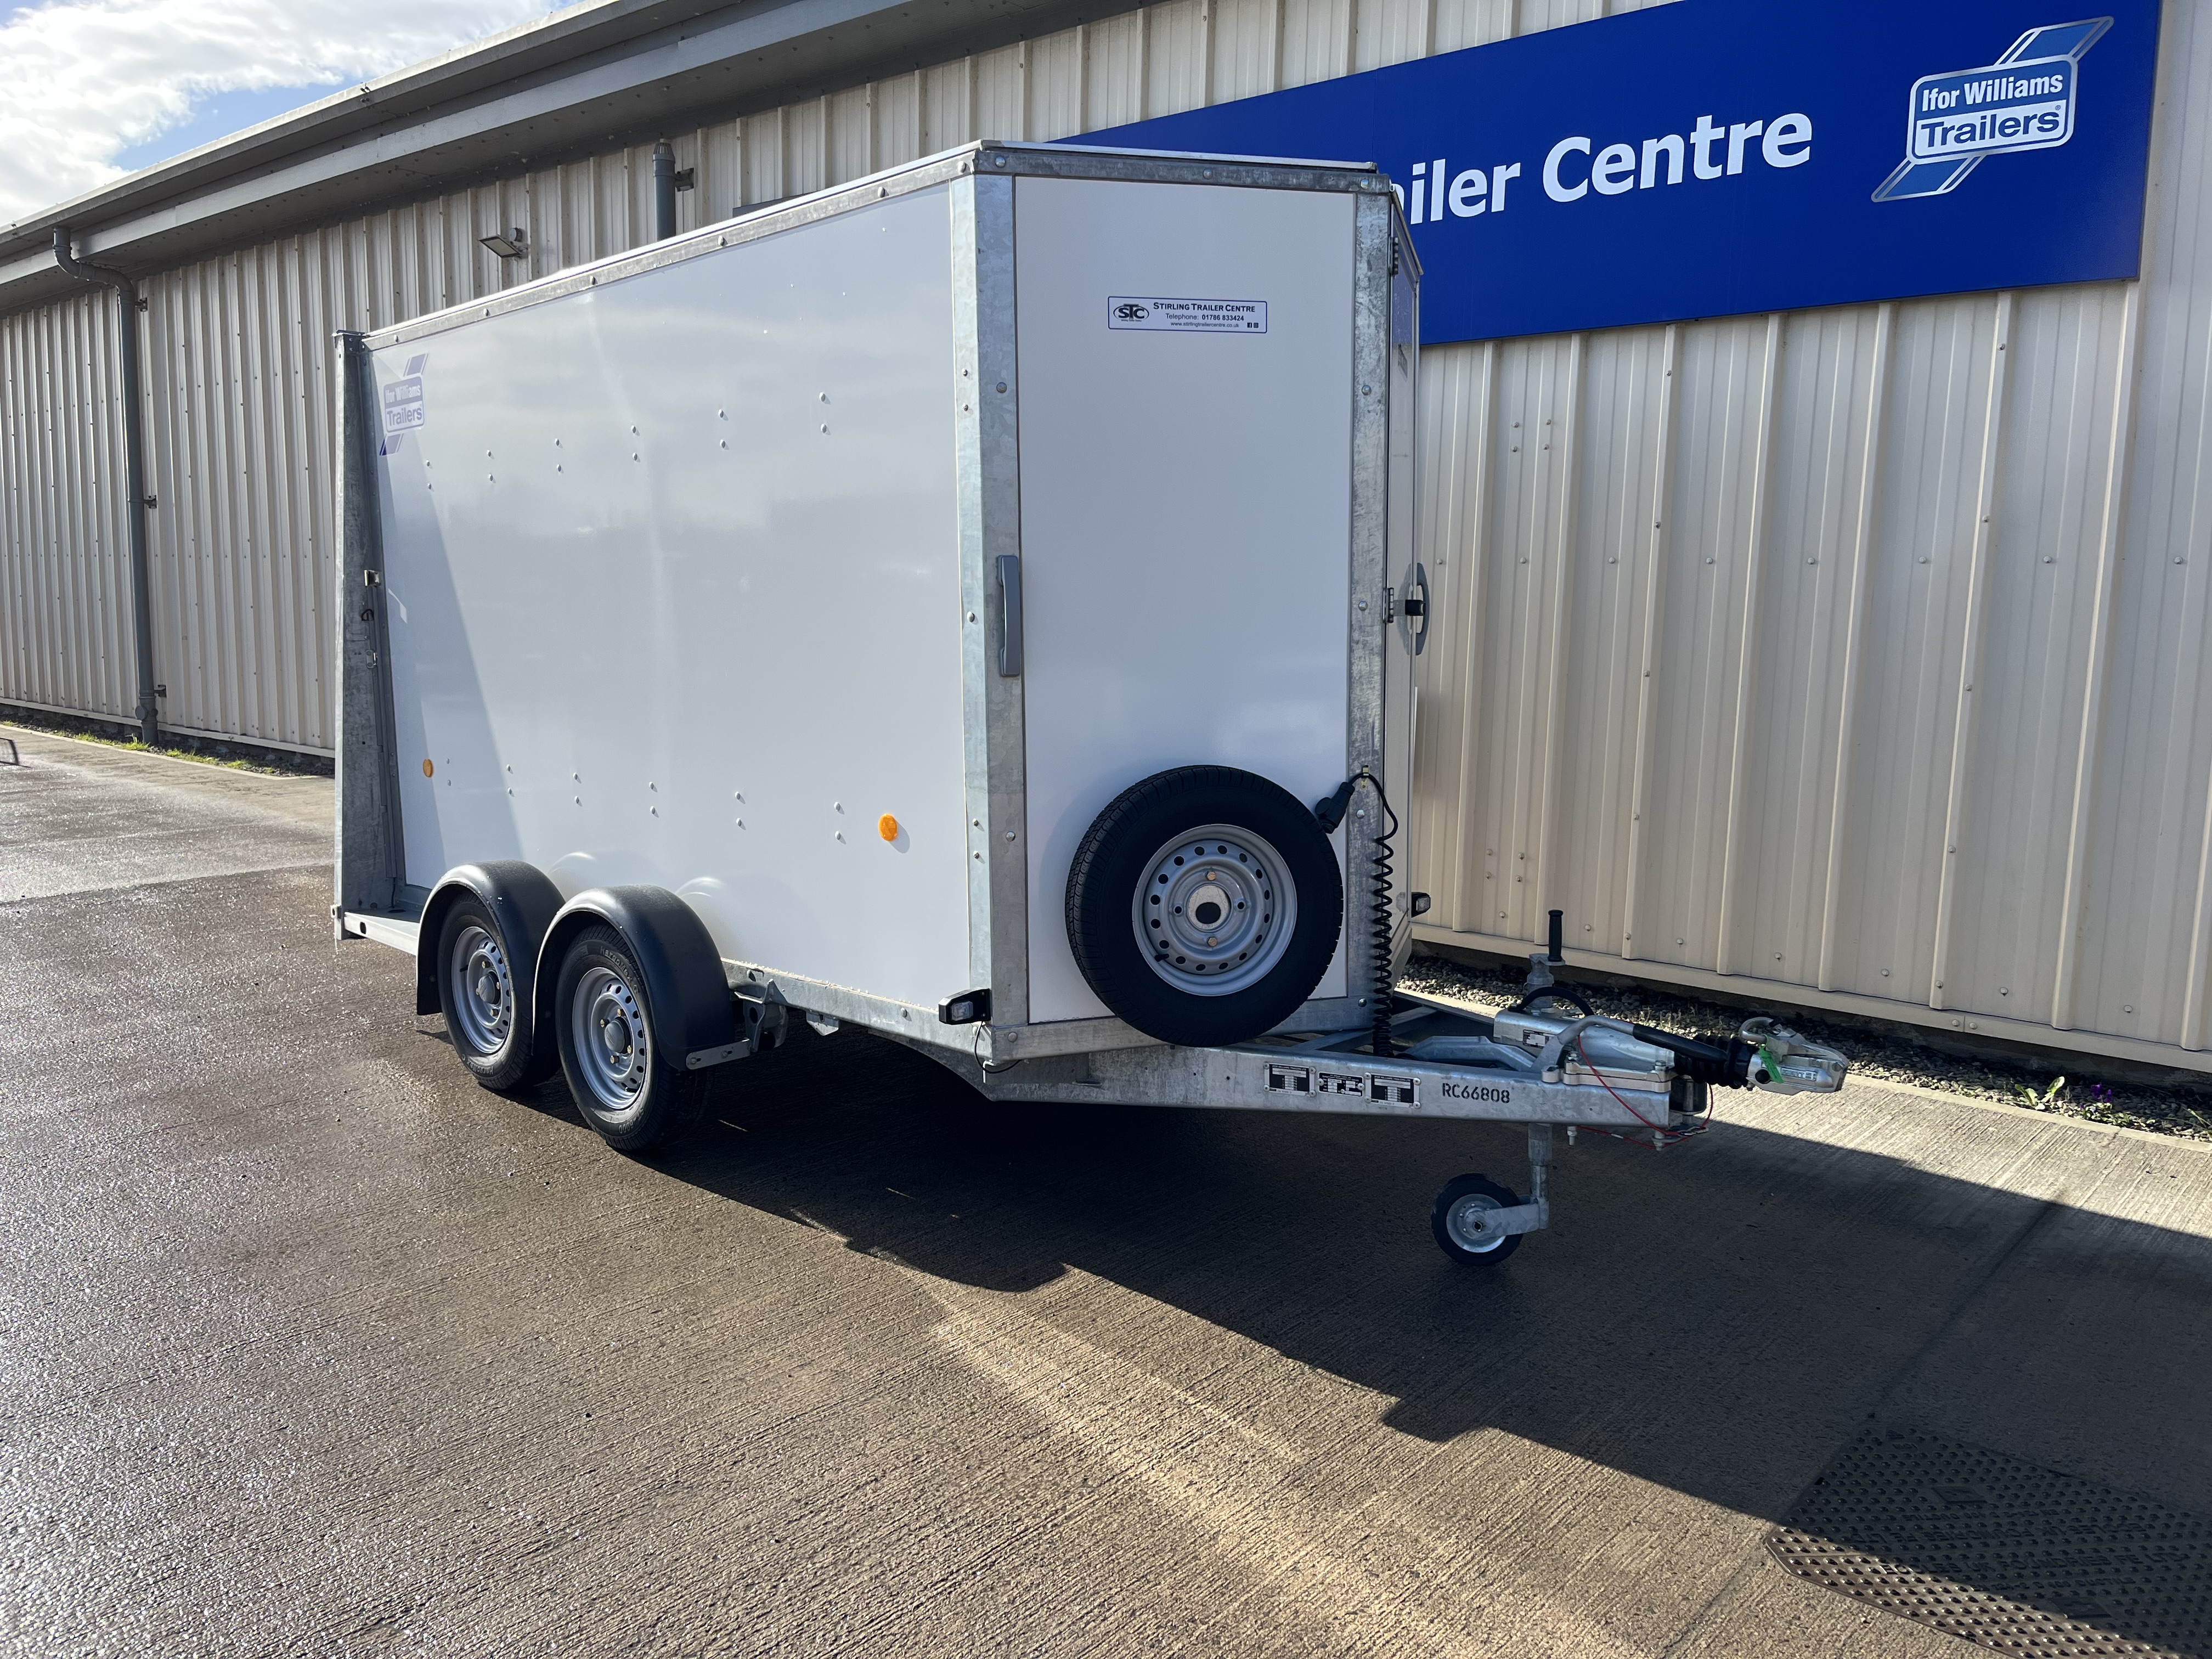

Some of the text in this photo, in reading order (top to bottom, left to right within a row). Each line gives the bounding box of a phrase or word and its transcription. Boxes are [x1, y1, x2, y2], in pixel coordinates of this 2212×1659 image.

[1922, 74, 2063, 111] Ifor Williams
[1921, 111, 2059, 148] Trailers
[1543, 112, 1812, 202] Centre
[1118, 303, 1145, 320] STC
[1153, 302, 1256, 313] STIRLING TRAILER CENTRE
[1166, 313, 1199, 321] Telephone:
[395, 385, 421, 401] Williams
[386, 407, 422, 426] Trailers
[1442, 1082, 1510, 1104] RC66808
